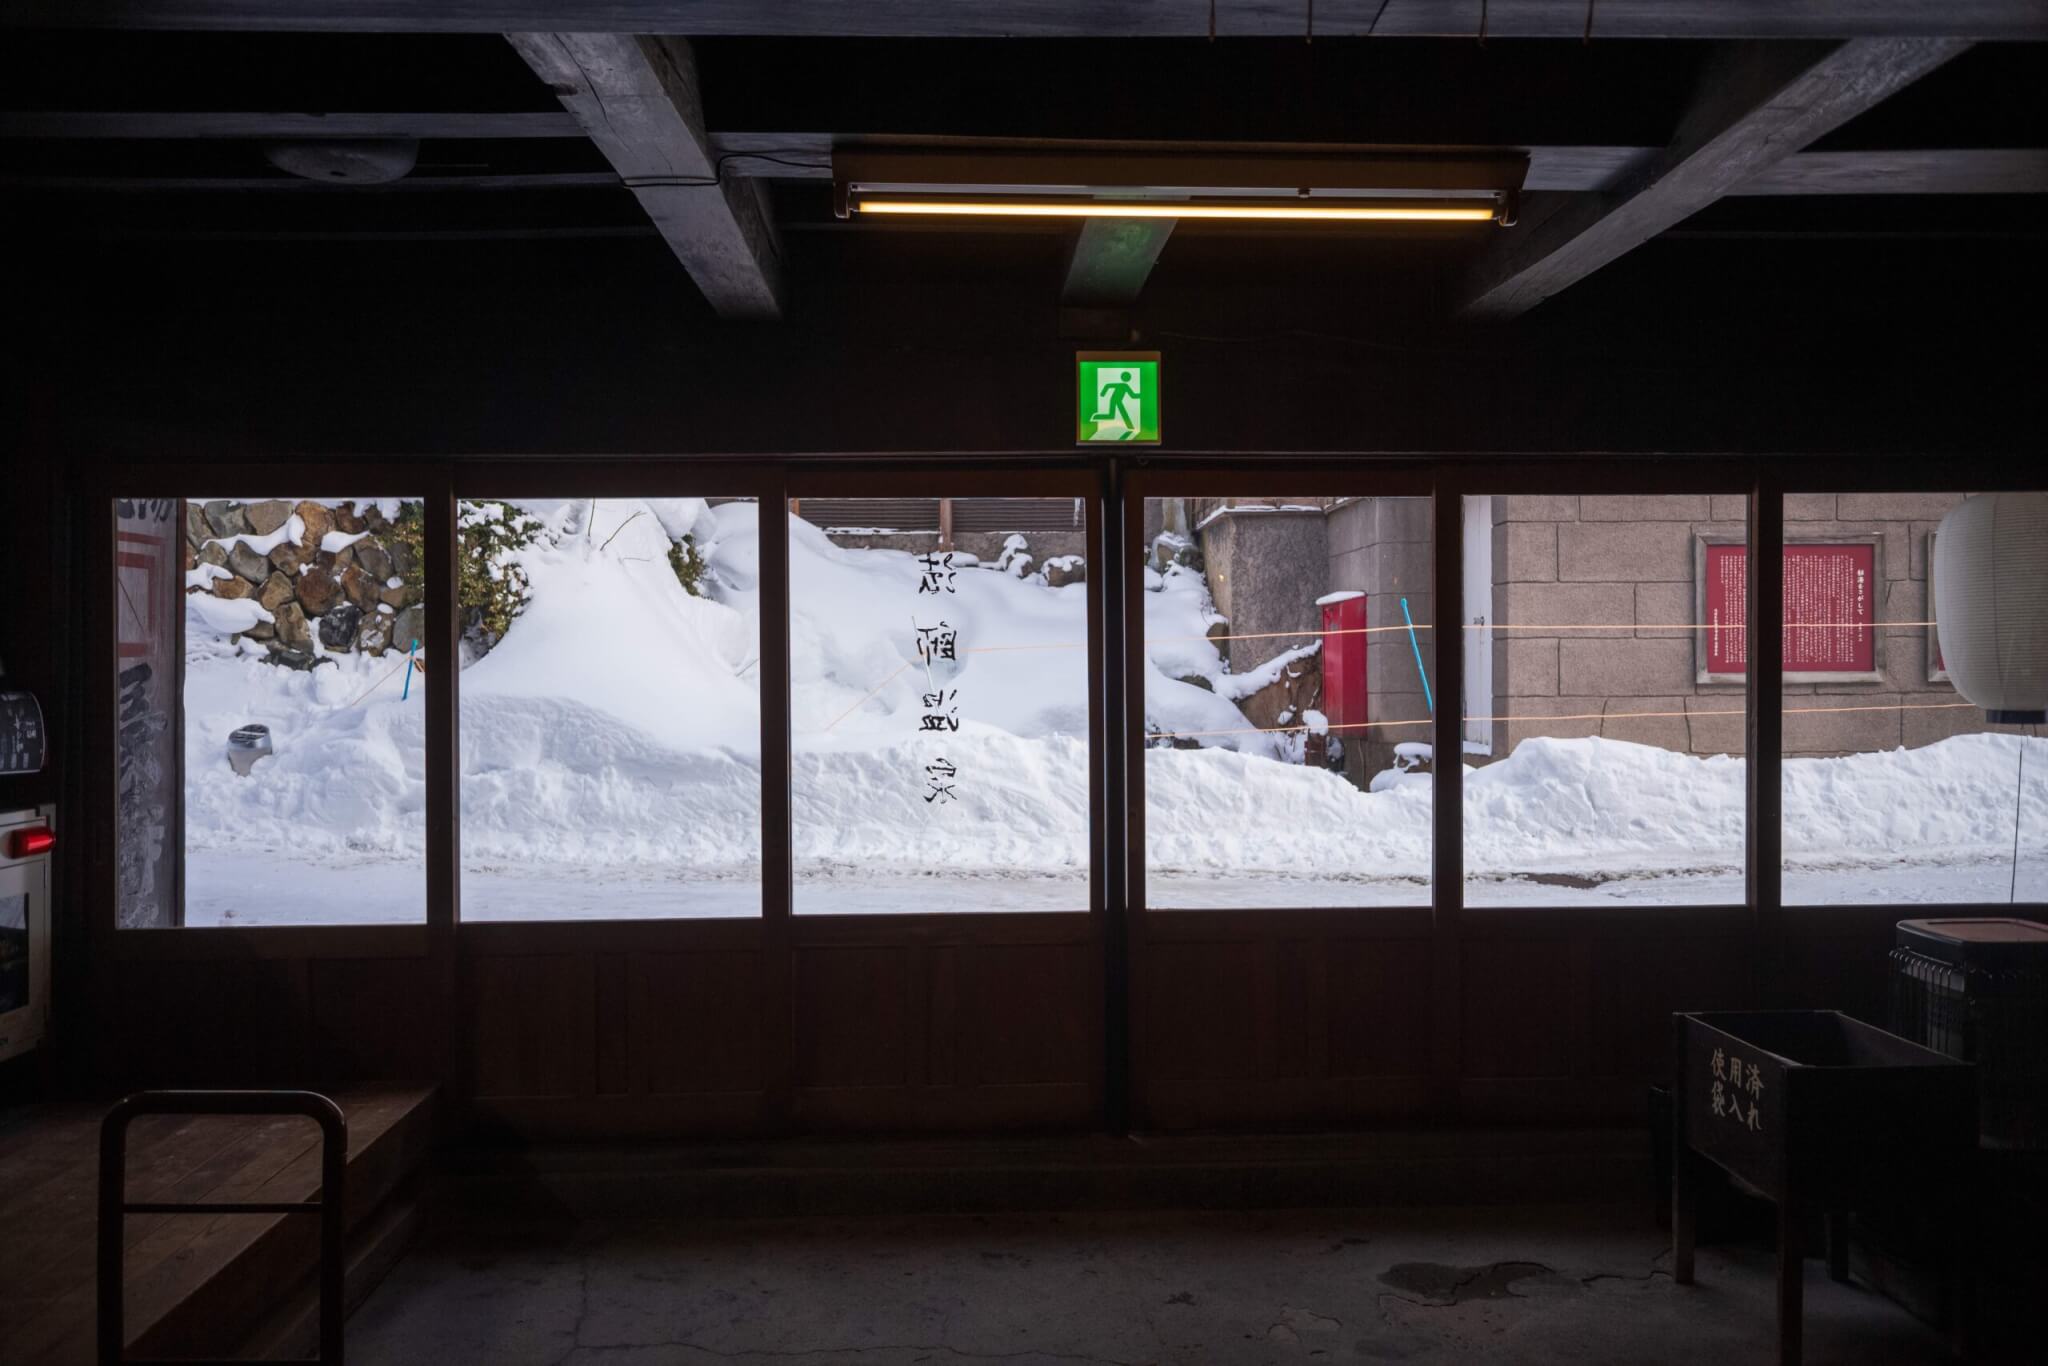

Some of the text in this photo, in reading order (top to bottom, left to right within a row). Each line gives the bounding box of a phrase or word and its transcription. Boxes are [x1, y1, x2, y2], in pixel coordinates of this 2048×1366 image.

[1711, 1047, 1765, 1100] 使用済
[1711, 1081, 1763, 1132] 袋入れ
